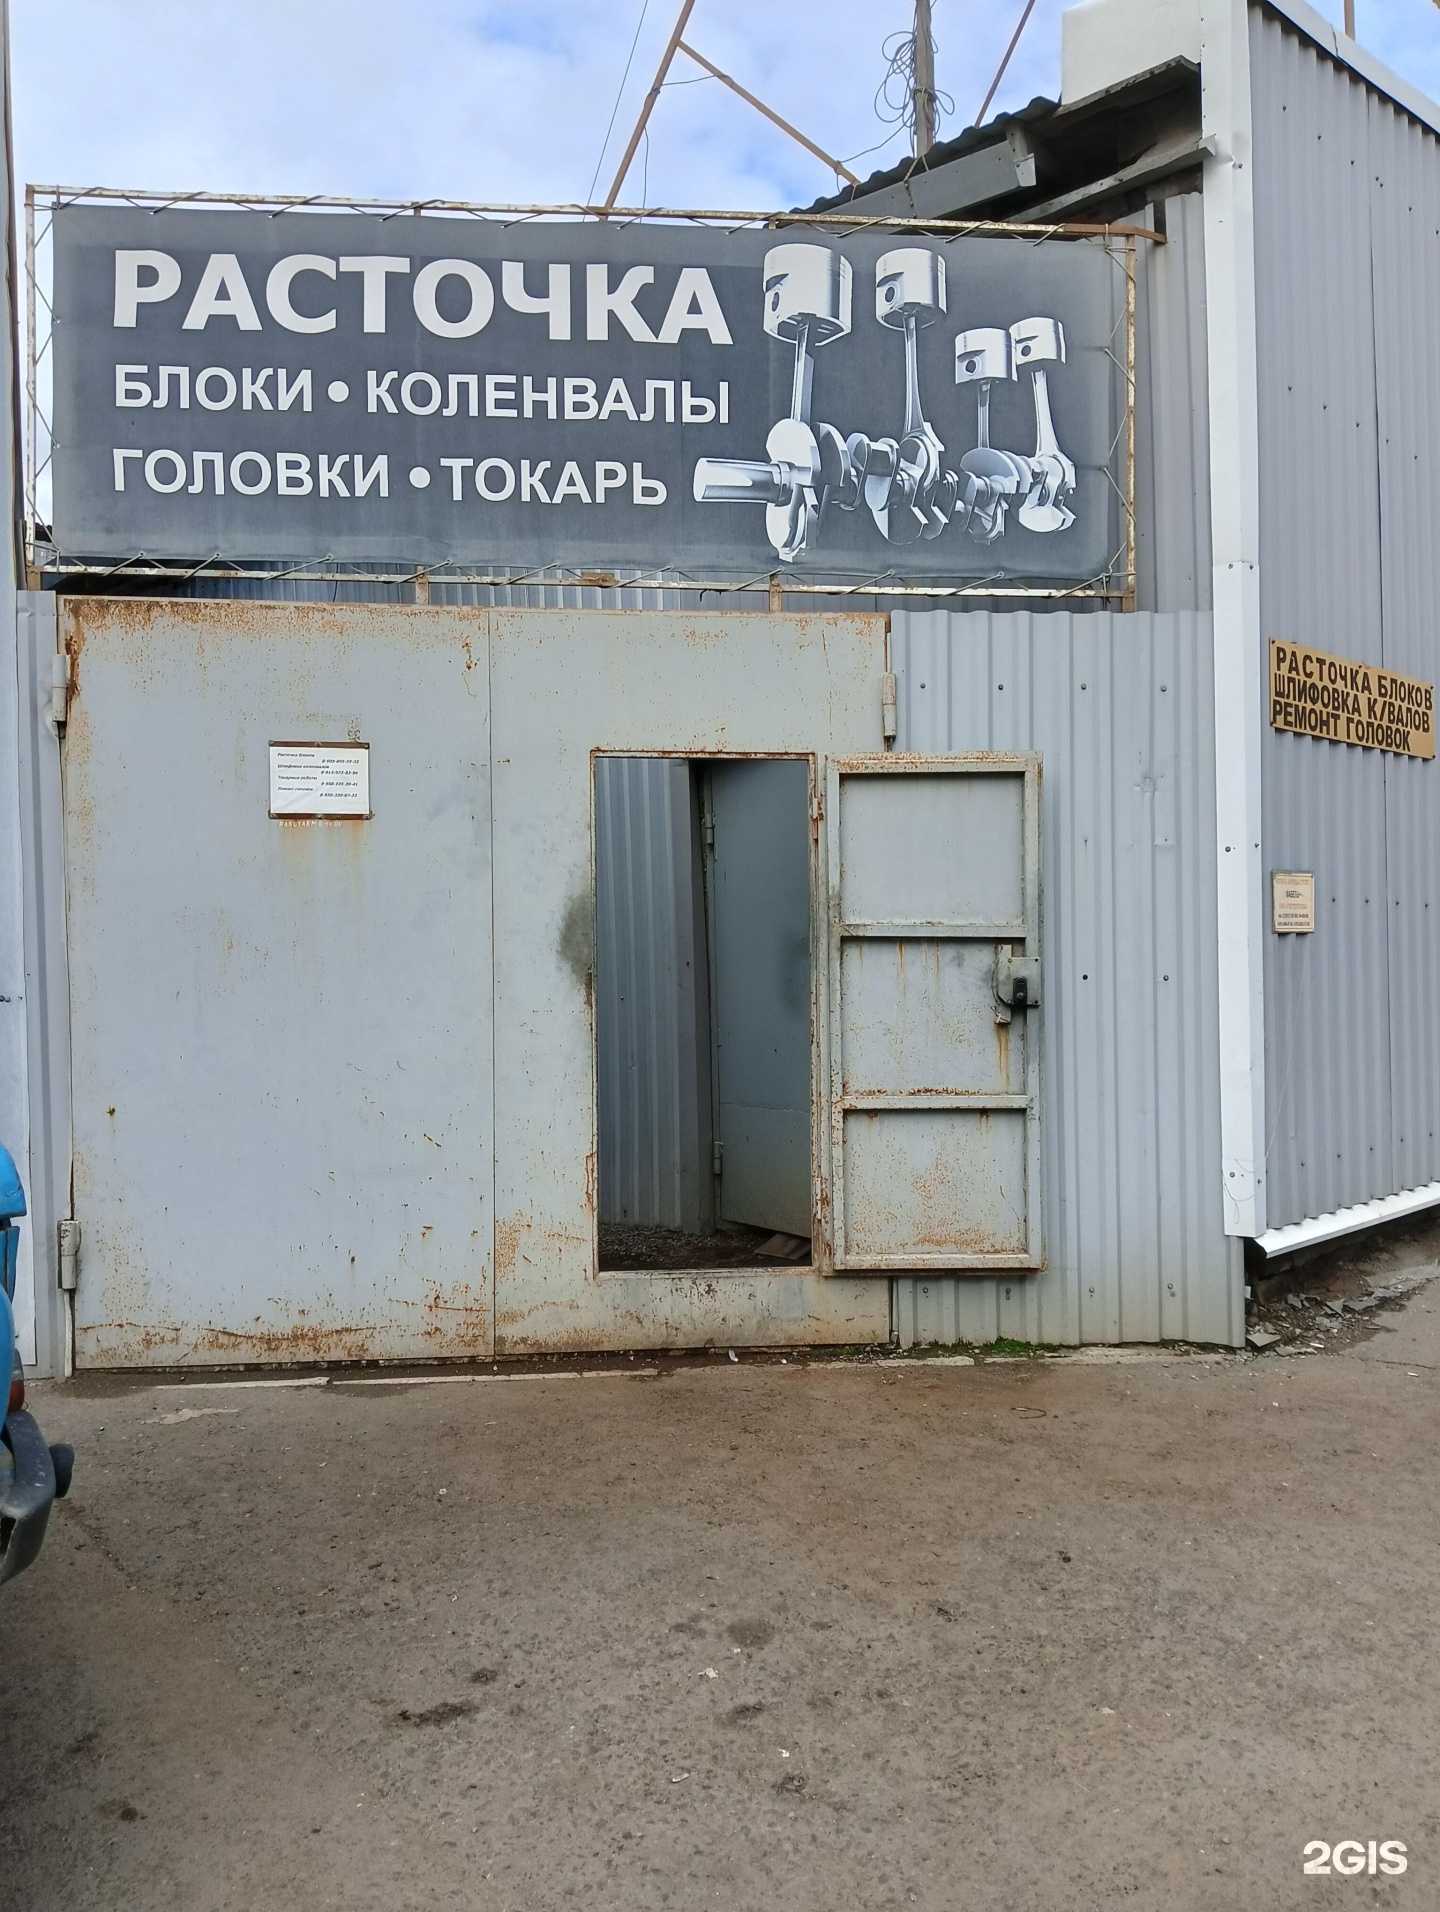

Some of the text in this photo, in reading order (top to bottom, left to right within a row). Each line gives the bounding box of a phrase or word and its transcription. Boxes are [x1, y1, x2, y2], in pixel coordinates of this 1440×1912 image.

[113, 249, 734, 345] РАСТОЧКА
[115, 364, 729, 424] БЛОКИ КОЛЕНВАЛЫ
[112, 448, 668, 505] ГОЛОВКИ ТОКАРЬ
[1274, 673, 1431, 734] ШЛИФОВКА К/ВАЛОВ
[1275, 646, 1433, 711] РАСТОЧКА БЛОКОВ
[1272, 698, 1411, 752] РЕМОНТ ГОЛОВОК
